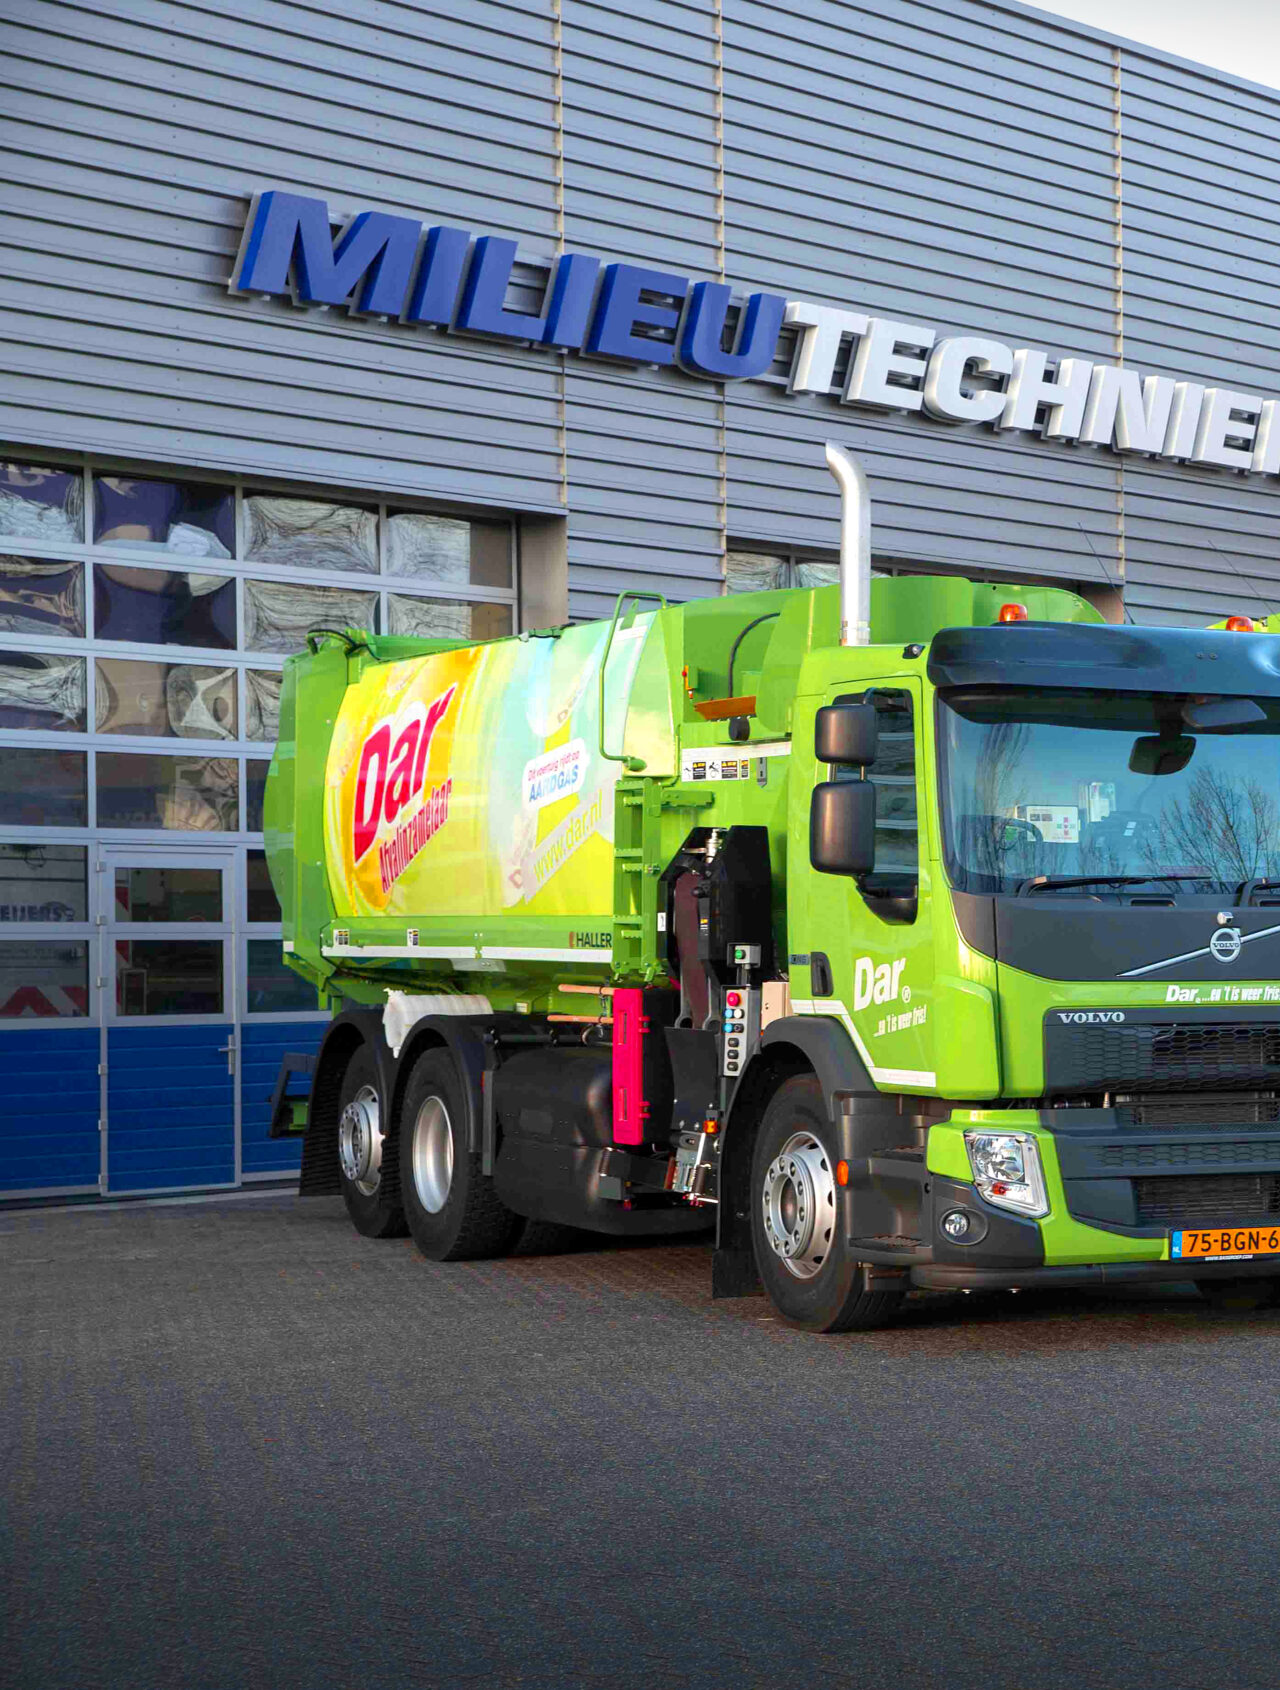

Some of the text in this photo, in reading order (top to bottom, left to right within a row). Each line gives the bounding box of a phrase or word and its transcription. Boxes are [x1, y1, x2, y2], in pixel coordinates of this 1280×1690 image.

[352, 684, 458, 866] Dar
[529, 764, 579, 802] AARDGAS
[379, 778, 452, 894] Afvalinzamelaar
[533, 788, 603, 884] www.dar.nl
[576, 932, 613, 949] HALLER
[1231, 985, 1240, 1001] is
[1241, 988, 1263, 1001] weer
[898, 1012, 912, 1030] weer
[1057, 1011, 1126, 1024] VOLVO
[1188, 1230, 1279, 1253] 75-BGN-6
